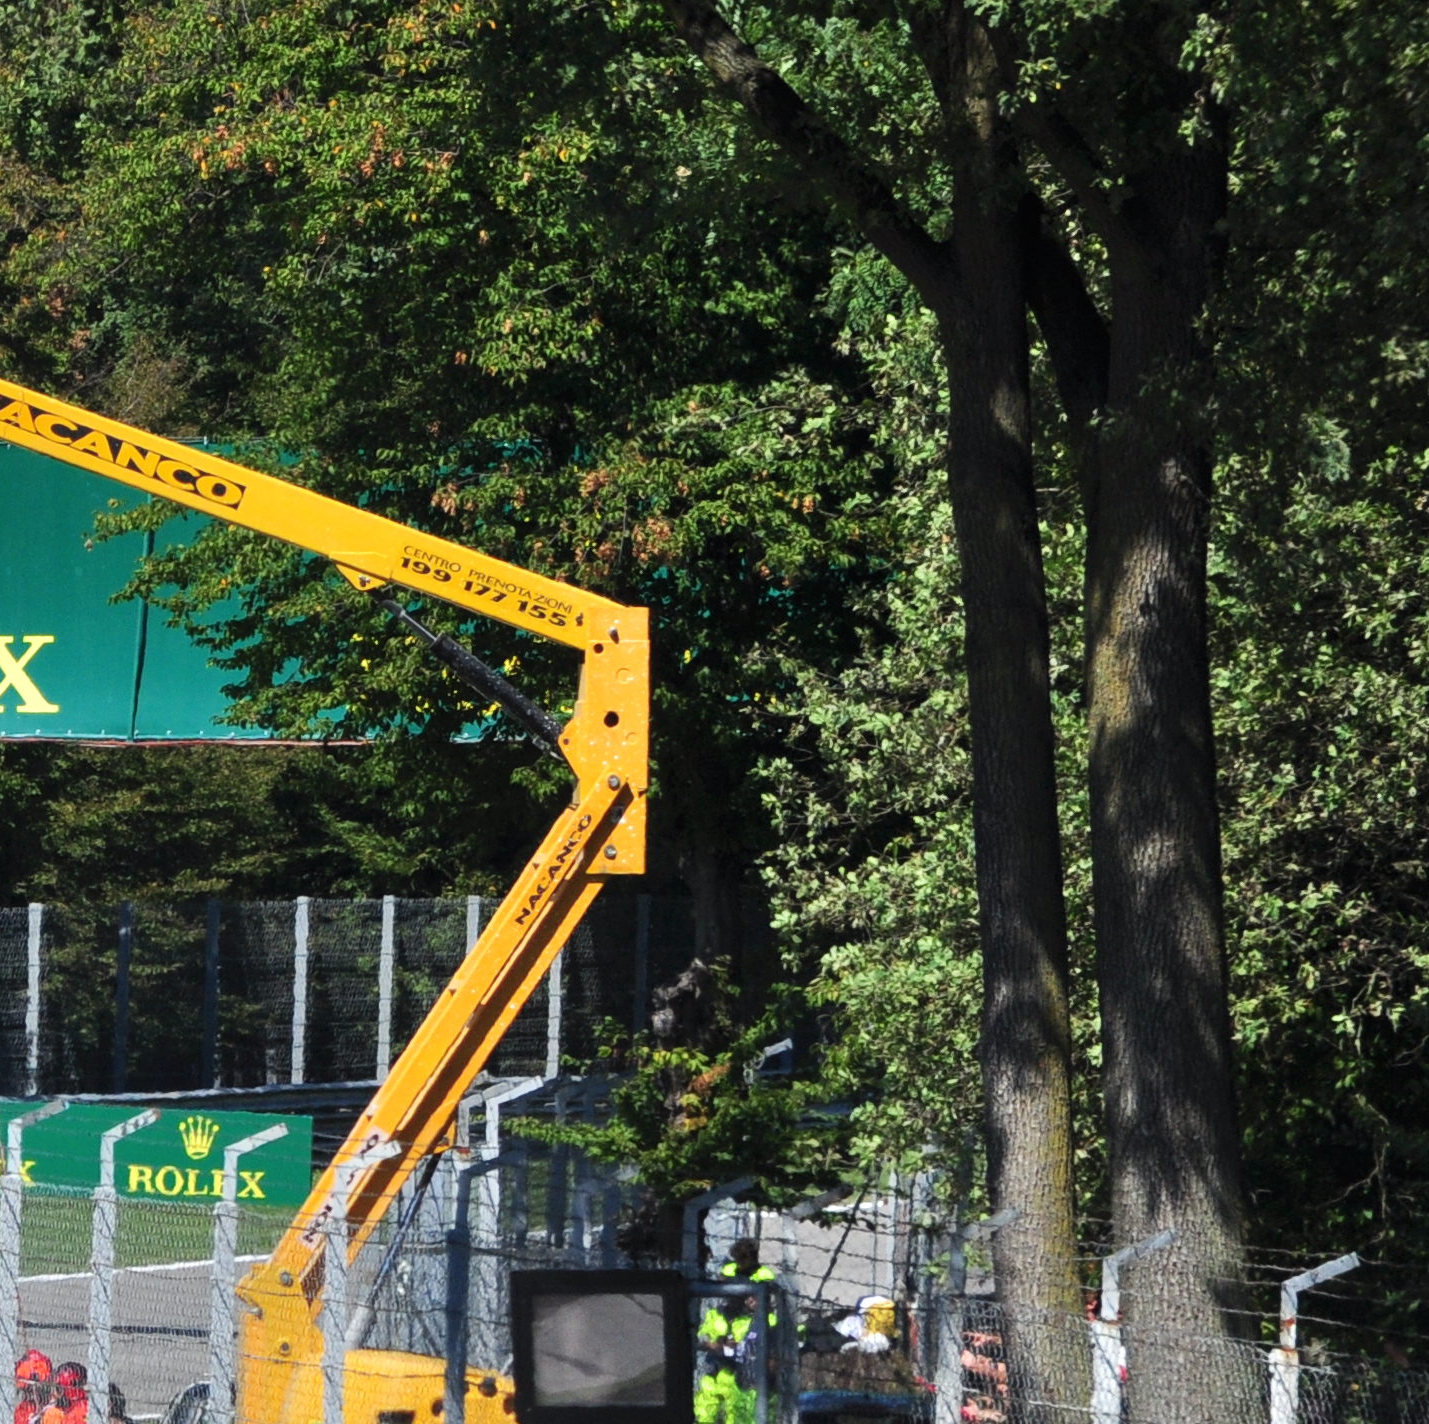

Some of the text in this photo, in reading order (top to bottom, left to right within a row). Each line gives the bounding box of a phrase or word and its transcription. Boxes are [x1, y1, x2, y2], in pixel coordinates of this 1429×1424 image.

[400, 556, 568, 628] 199 177 155
[403, 545, 573, 614] CENTRO PRENOTAZIONI
[514, 814, 592, 926] NACANCO
